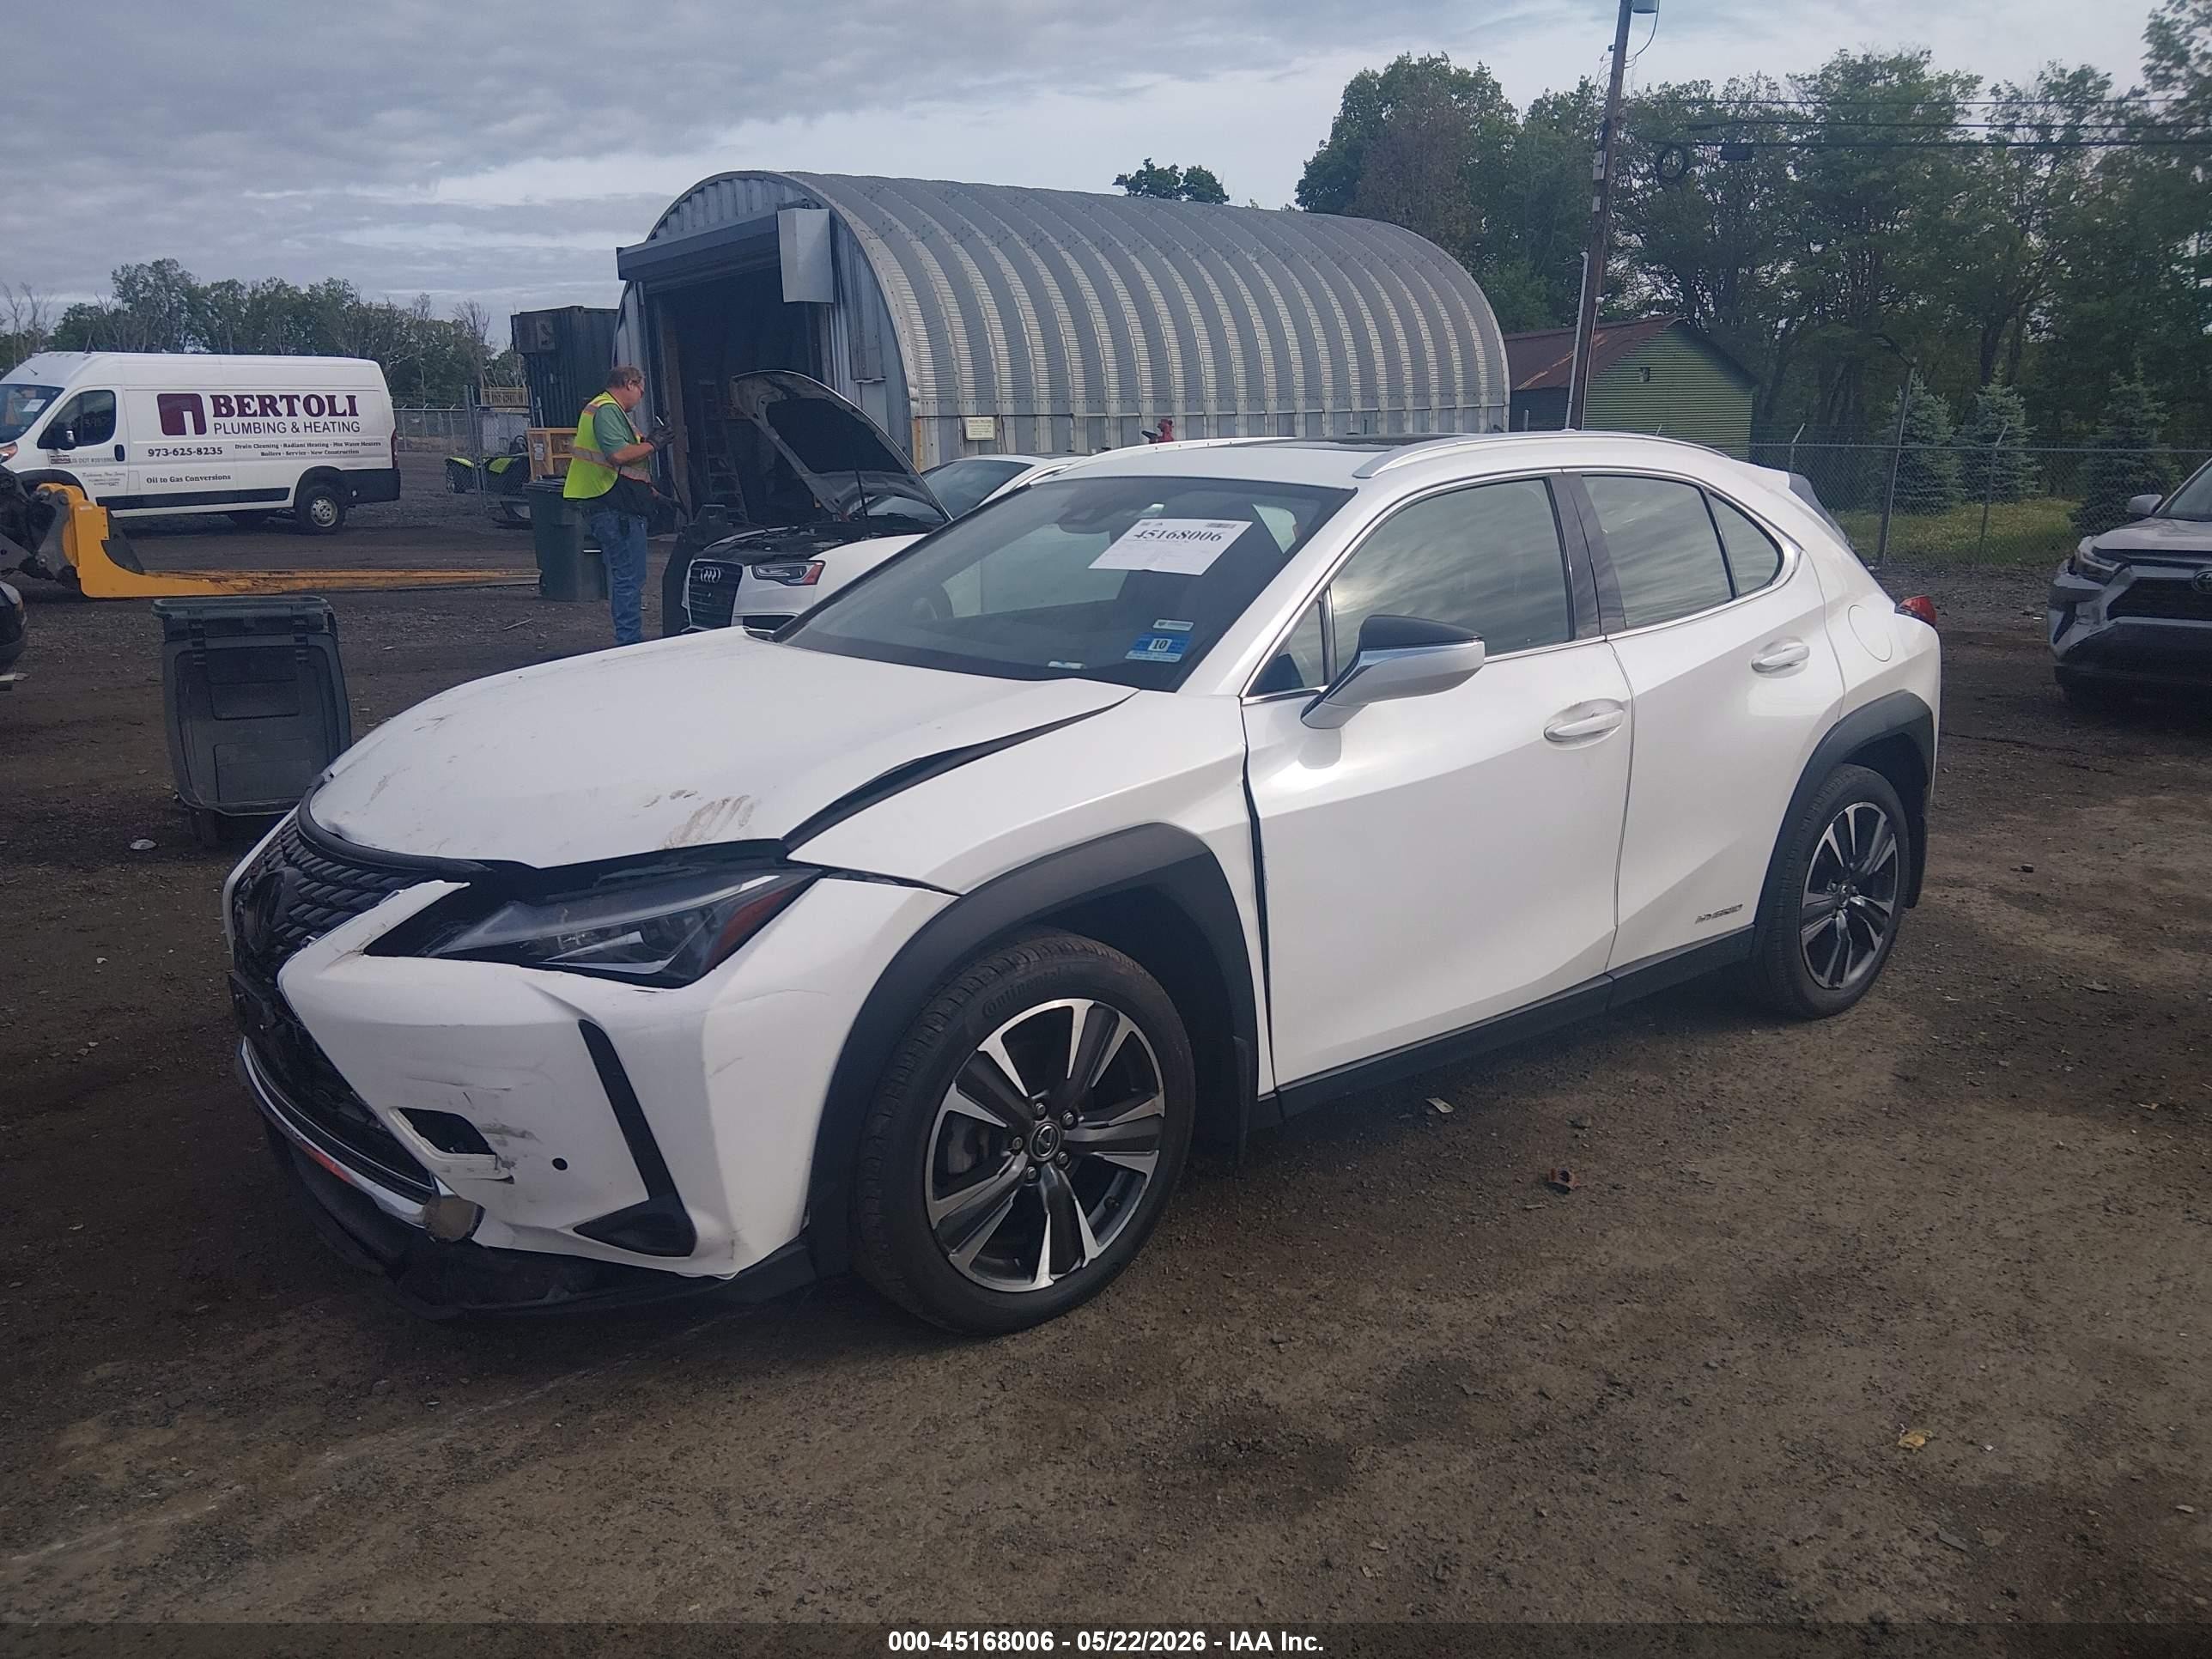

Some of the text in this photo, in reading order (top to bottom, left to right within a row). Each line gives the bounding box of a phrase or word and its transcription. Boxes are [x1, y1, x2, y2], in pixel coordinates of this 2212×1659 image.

[210, 394, 359, 417] BERTOLI
[214, 421, 361, 434] PLUMBING & HEATING
[148, 447, 223, 457] 973-625-8235
[1133, 529, 1226, 542] 45168006
[1152, 639, 1168, 649] 10
